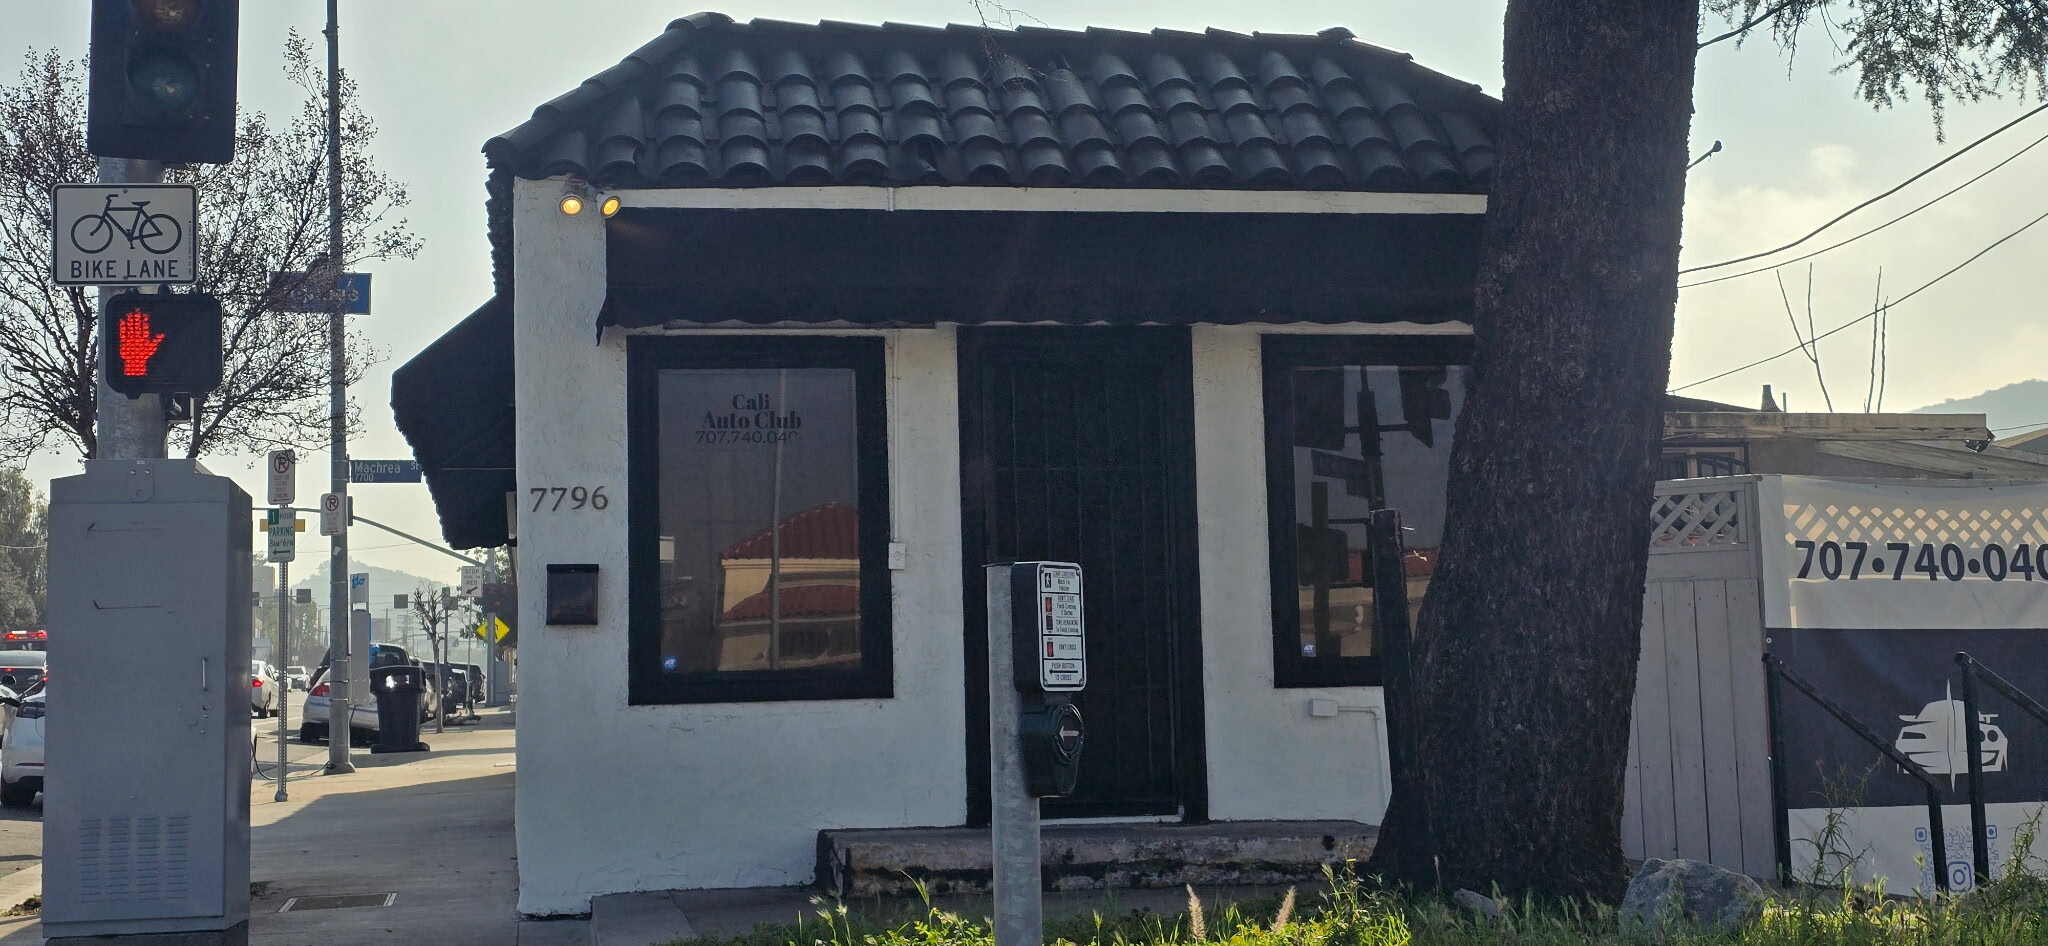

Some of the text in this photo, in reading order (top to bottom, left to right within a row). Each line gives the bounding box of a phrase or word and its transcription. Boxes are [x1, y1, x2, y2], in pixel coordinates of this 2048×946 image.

[71, 260, 179, 279] BIKE LANE
[732, 392, 770, 410] Cali
[703, 410, 802, 429] Auto Club
[354, 461, 420, 473] Machrea St
[354, 473, 374, 481] 7700
[530, 486, 609, 512] 7796
[280, 512, 294, 520] HOUR
[269, 527, 294, 538] PARKING
[352, 575, 366, 589] flo
